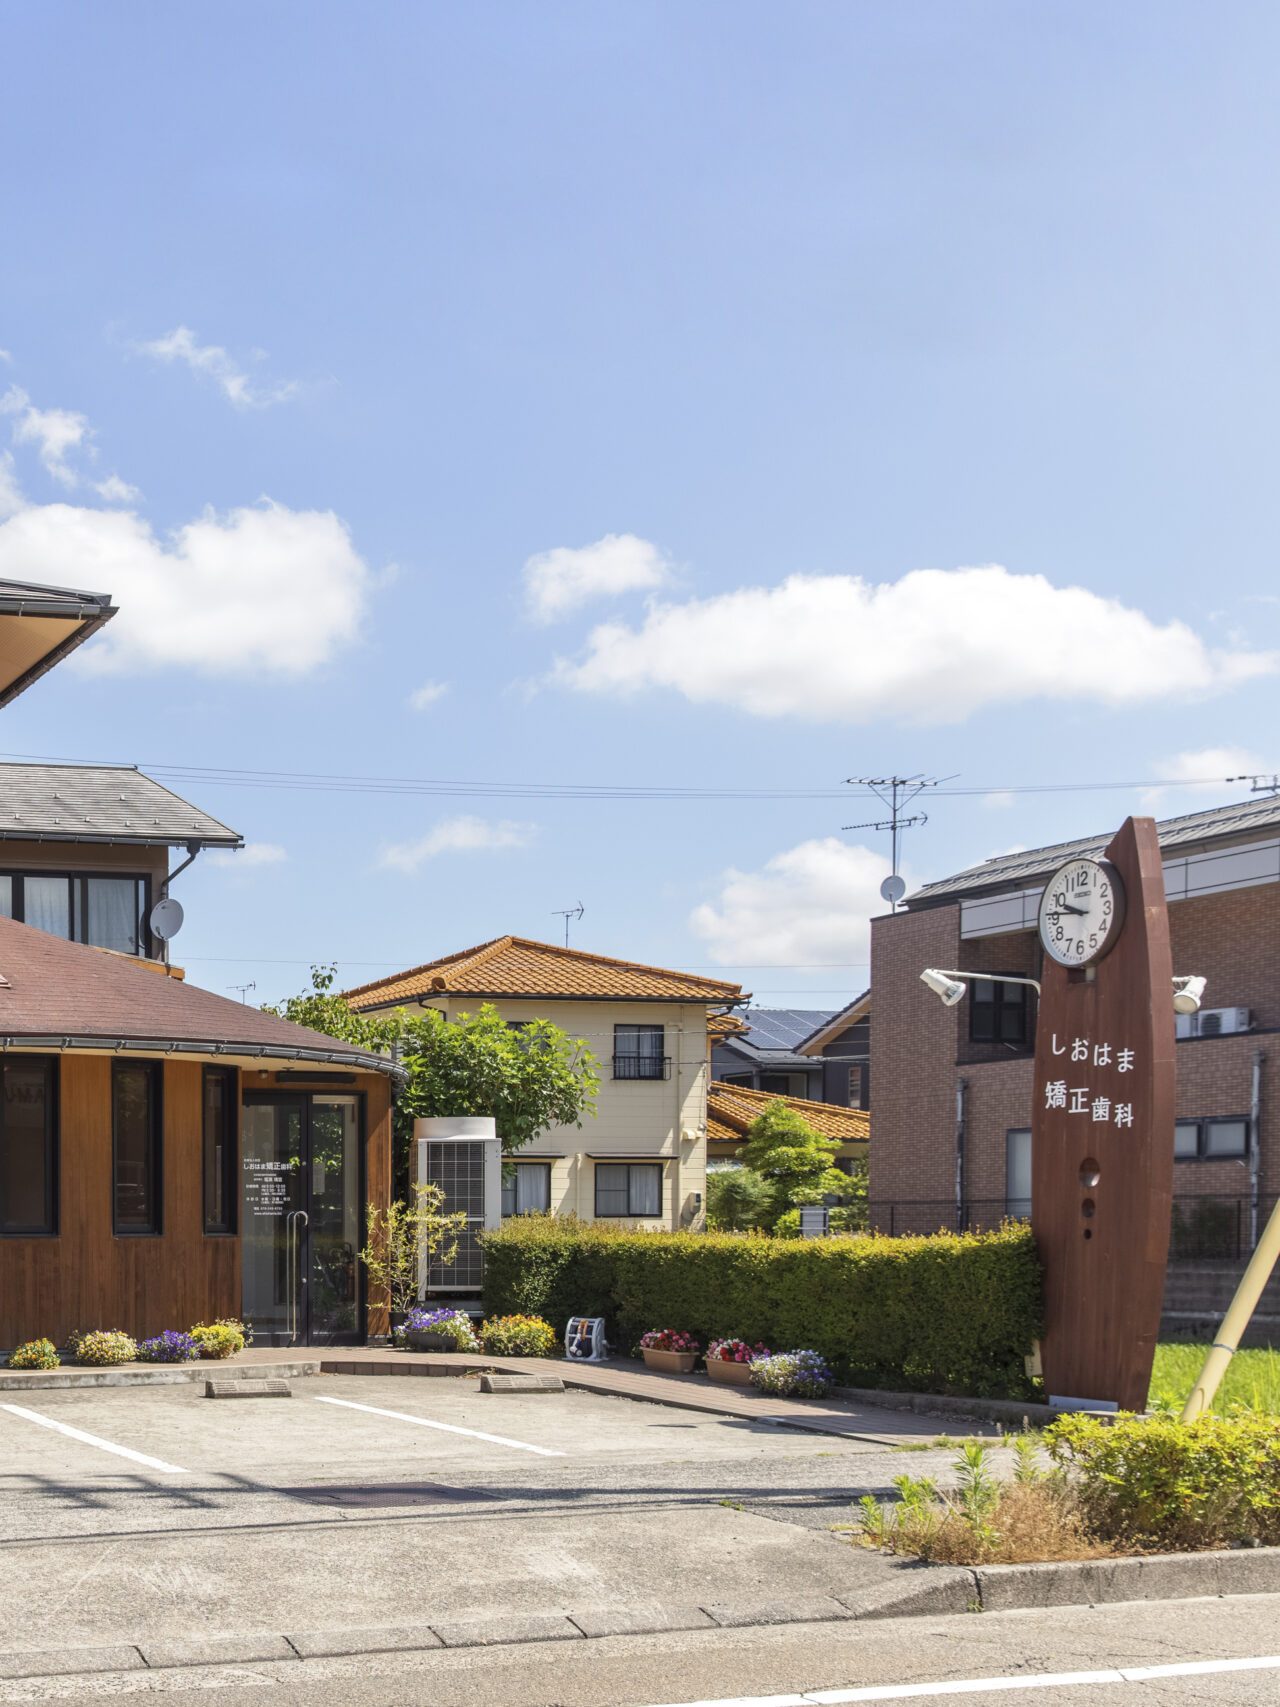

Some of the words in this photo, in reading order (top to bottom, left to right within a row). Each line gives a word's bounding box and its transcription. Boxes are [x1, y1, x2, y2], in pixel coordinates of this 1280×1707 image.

[1066, 877, 1074, 893] 11
[1077, 871, 1088, 886] 12
[1100, 883, 1108, 898] 2
[1053, 892, 1066, 908] 10
[1103, 900, 1111, 915] 3
[1051, 911, 1060, 926] 9
[1099, 918, 1108, 933] 4
[1056, 926, 1064, 941] 8
[1089, 933, 1097, 948] 5
[1065, 938, 1073, 952] 7
[1076, 940, 1084, 955] 6
[1052, 1033, 1135, 1073] しおはま
[1045, 1080, 1134, 1128] 矯正歯科
